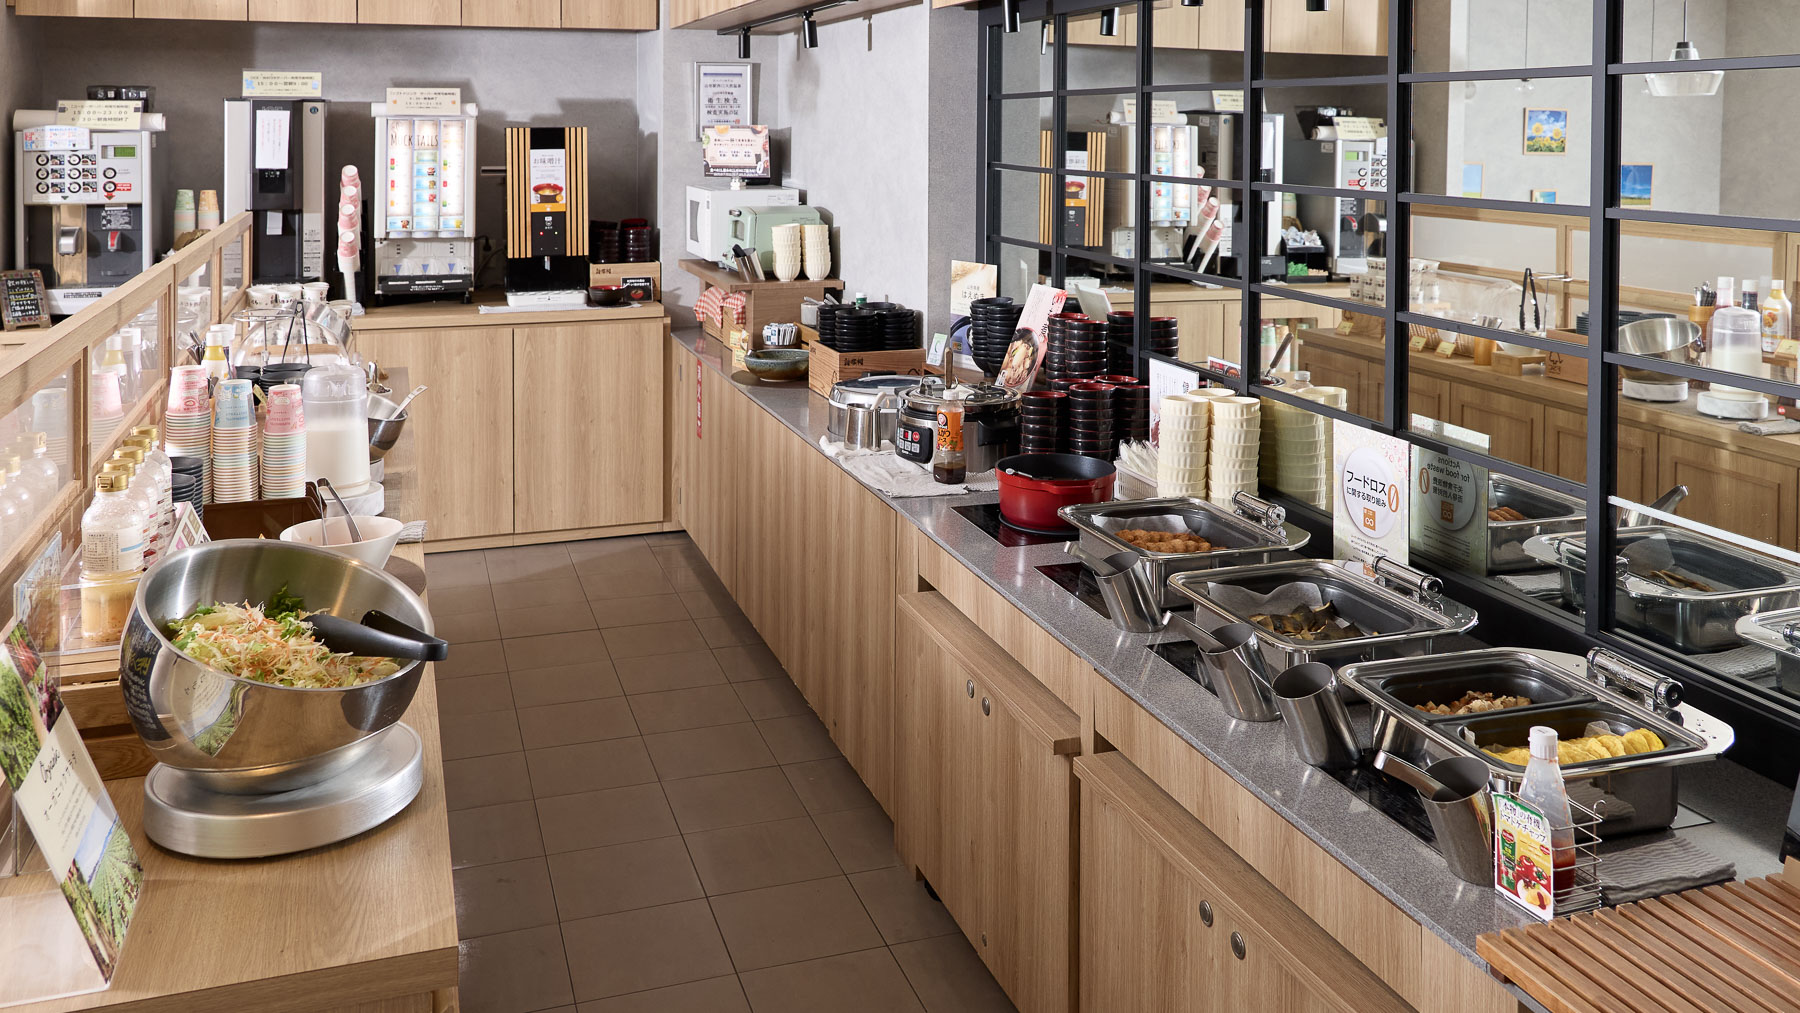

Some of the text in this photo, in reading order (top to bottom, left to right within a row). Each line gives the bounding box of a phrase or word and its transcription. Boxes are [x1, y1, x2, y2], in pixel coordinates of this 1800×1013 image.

[1346, 470, 1387, 496] フードロス
[1346, 486, 1387, 508] に関する取り組み
